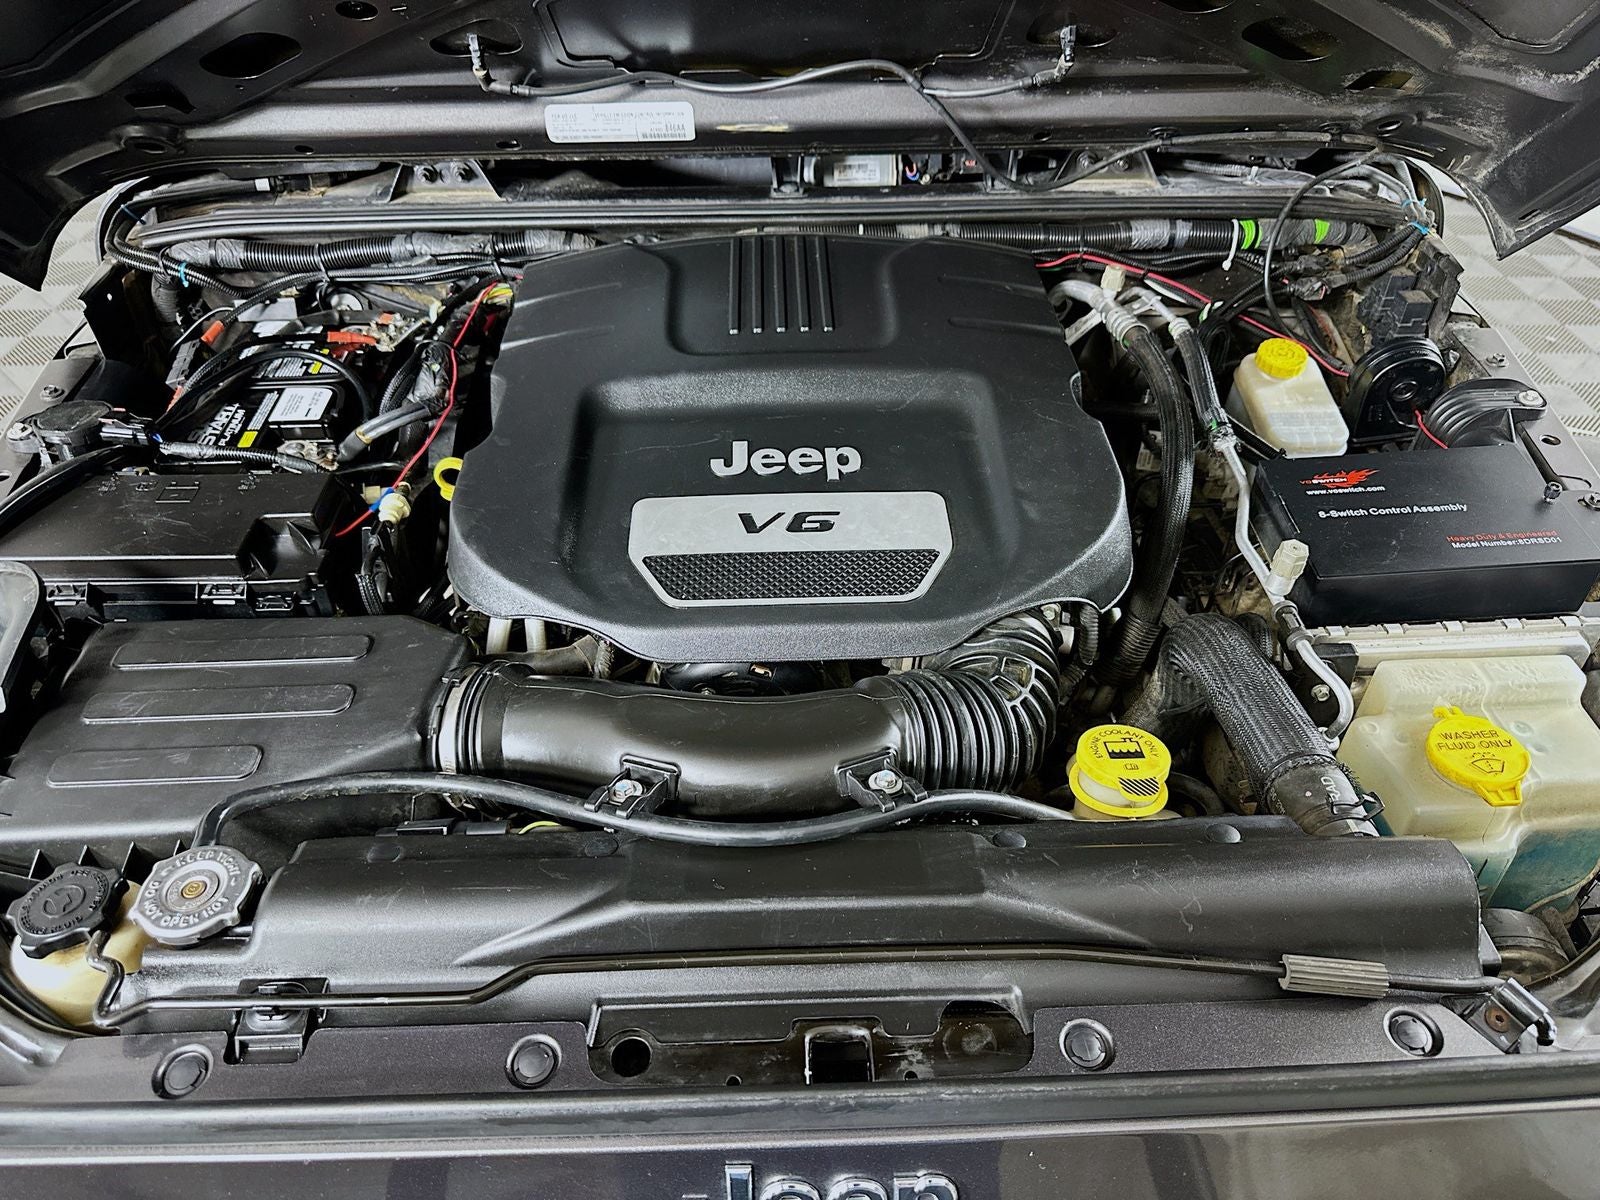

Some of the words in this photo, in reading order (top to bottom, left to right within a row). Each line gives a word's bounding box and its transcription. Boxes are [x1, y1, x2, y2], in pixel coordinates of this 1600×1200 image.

[709, 440, 862, 482] Jeep
[1317, 508, 1368, 518] 8-Switch
[1368, 506, 1411, 516] Control
[1412, 503, 1467, 513] Assembly
[737, 511, 841, 534] V6
[1446, 535, 1475, 543] Heavy
[1476, 533, 1497, 541] Duty
[1505, 530, 1558, 539] Engineered
[1451, 541, 1480, 549] Model
[1440, 730, 1500, 740] WASHER
[1090, 736, 1103, 758] ENGINE
[1099, 729, 1145, 740] COOLANT
[1437, 741, 1476, 751] FLUID
[1479, 739, 1513, 749] ONLY
[160, 913, 199, 928] OPEN
